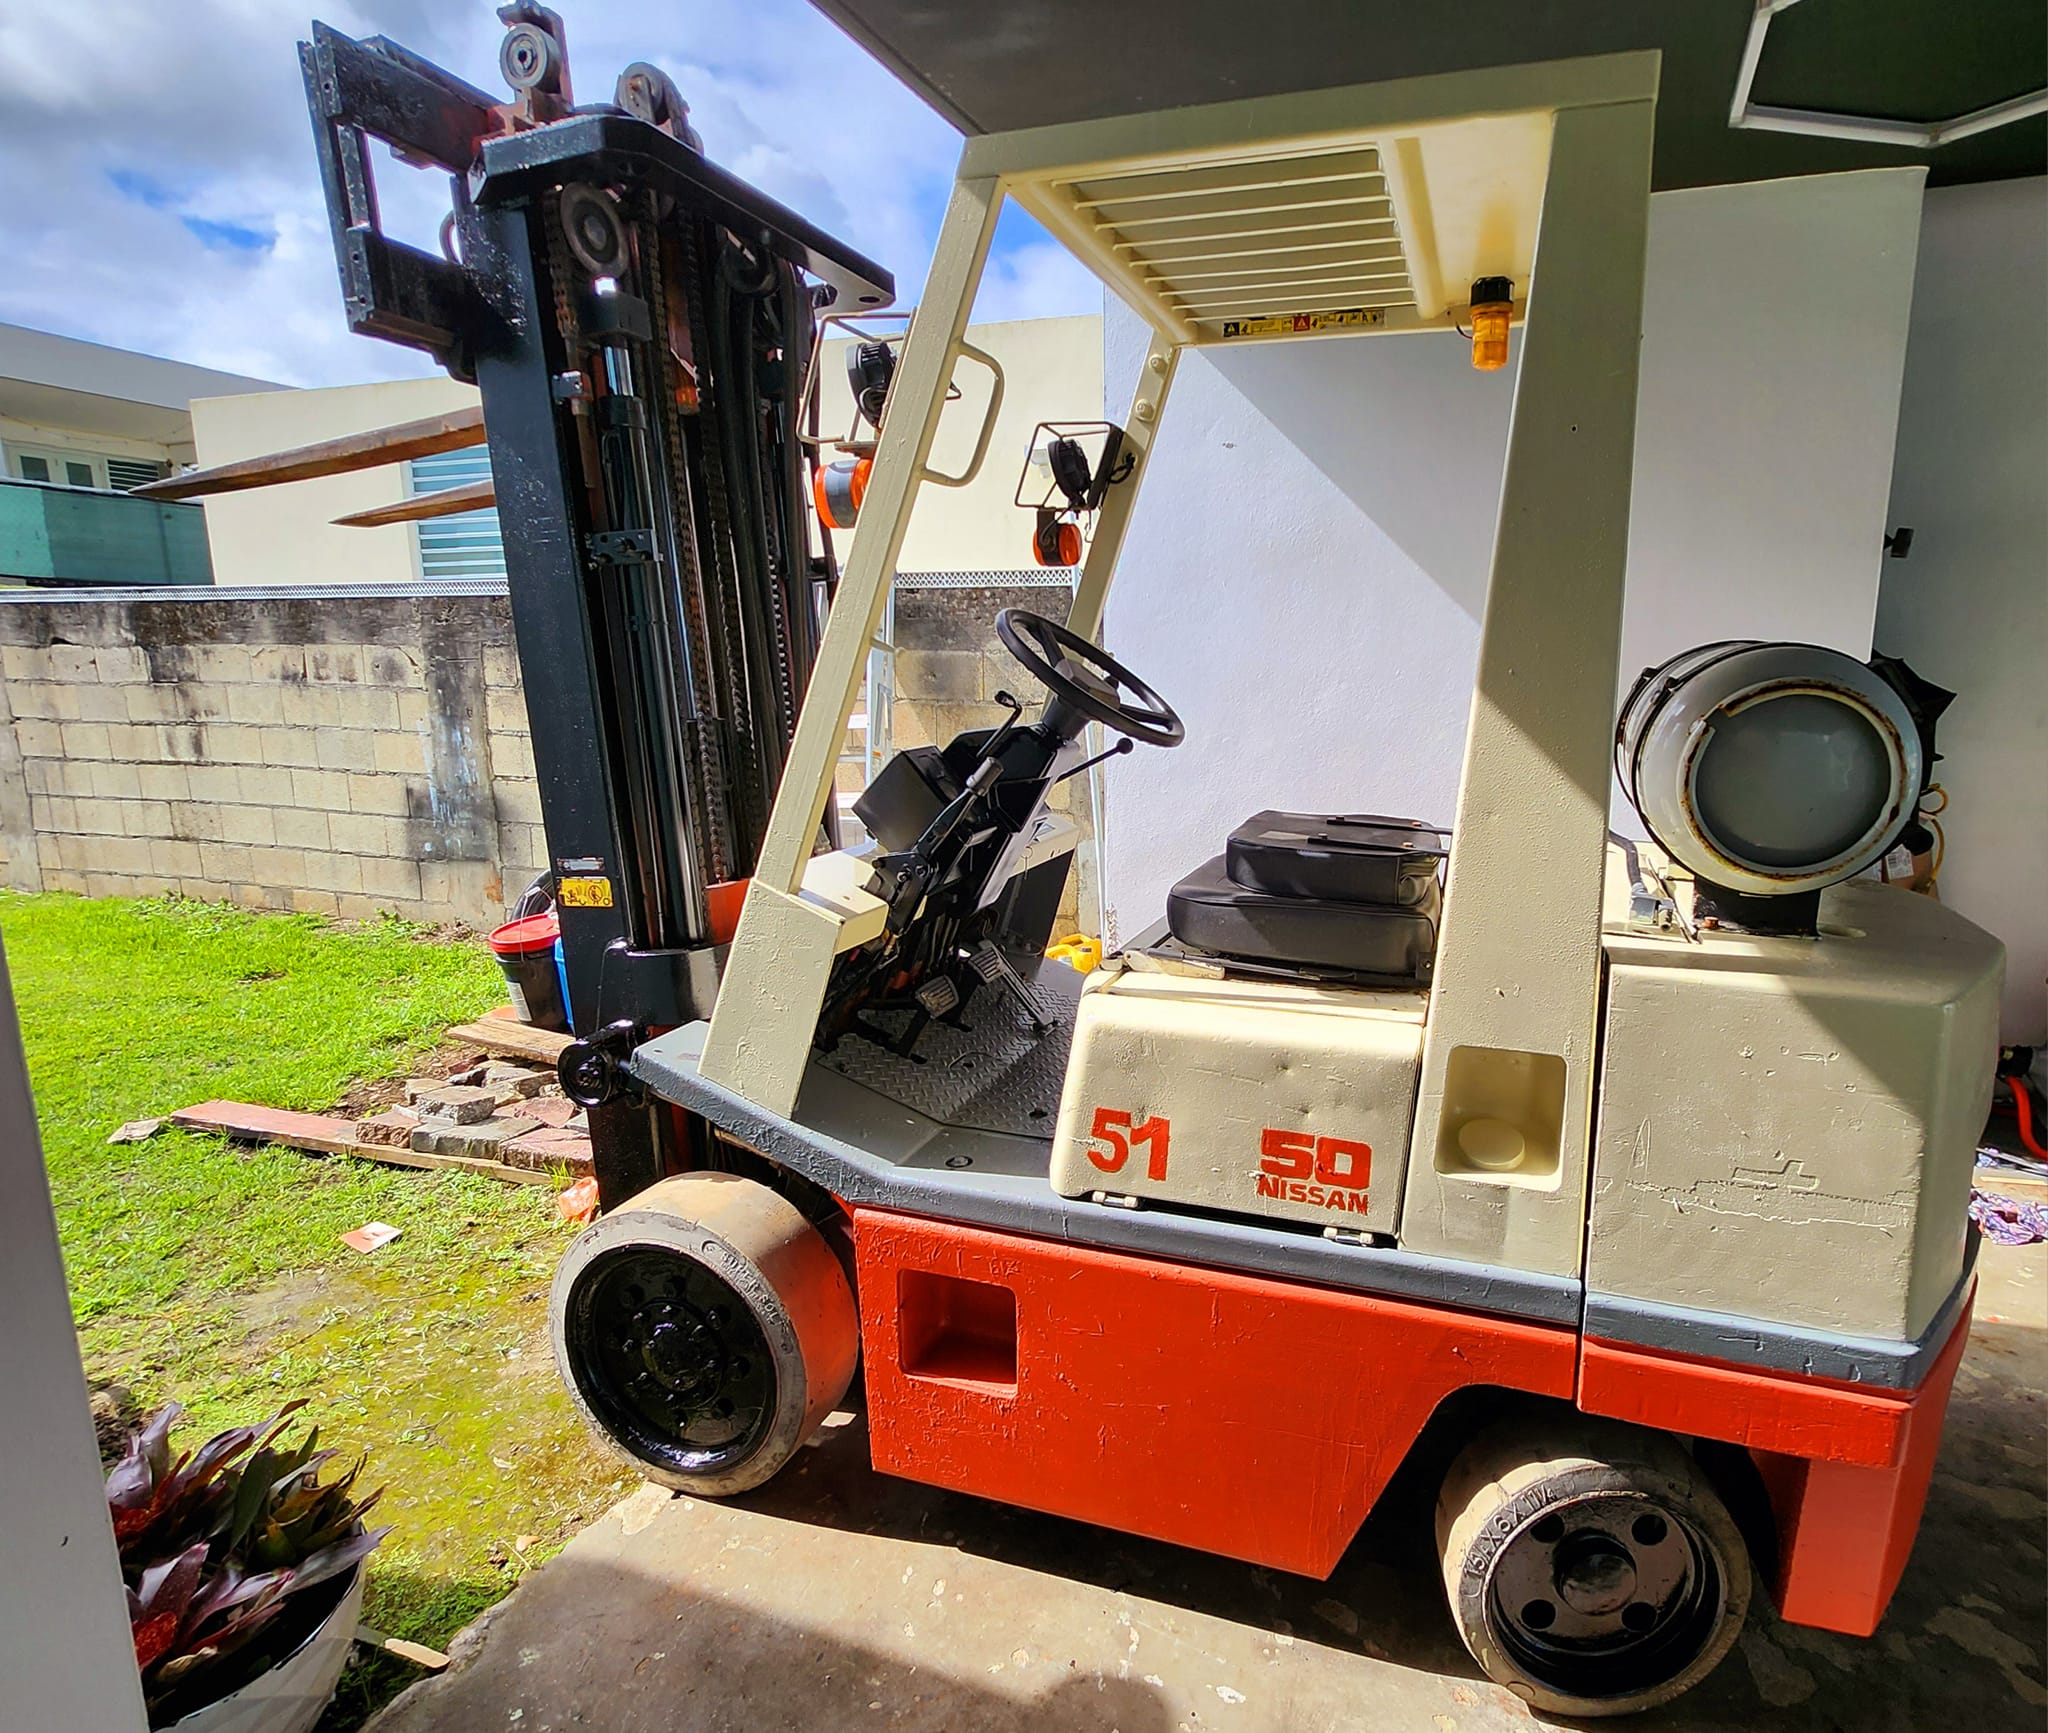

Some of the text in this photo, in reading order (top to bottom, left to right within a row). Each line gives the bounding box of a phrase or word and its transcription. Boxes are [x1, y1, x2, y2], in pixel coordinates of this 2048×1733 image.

[1087, 1107, 1170, 1181] 51
[1260, 1128, 1372, 1190] 50
[1257, 1174, 1370, 1216] NISSAN
